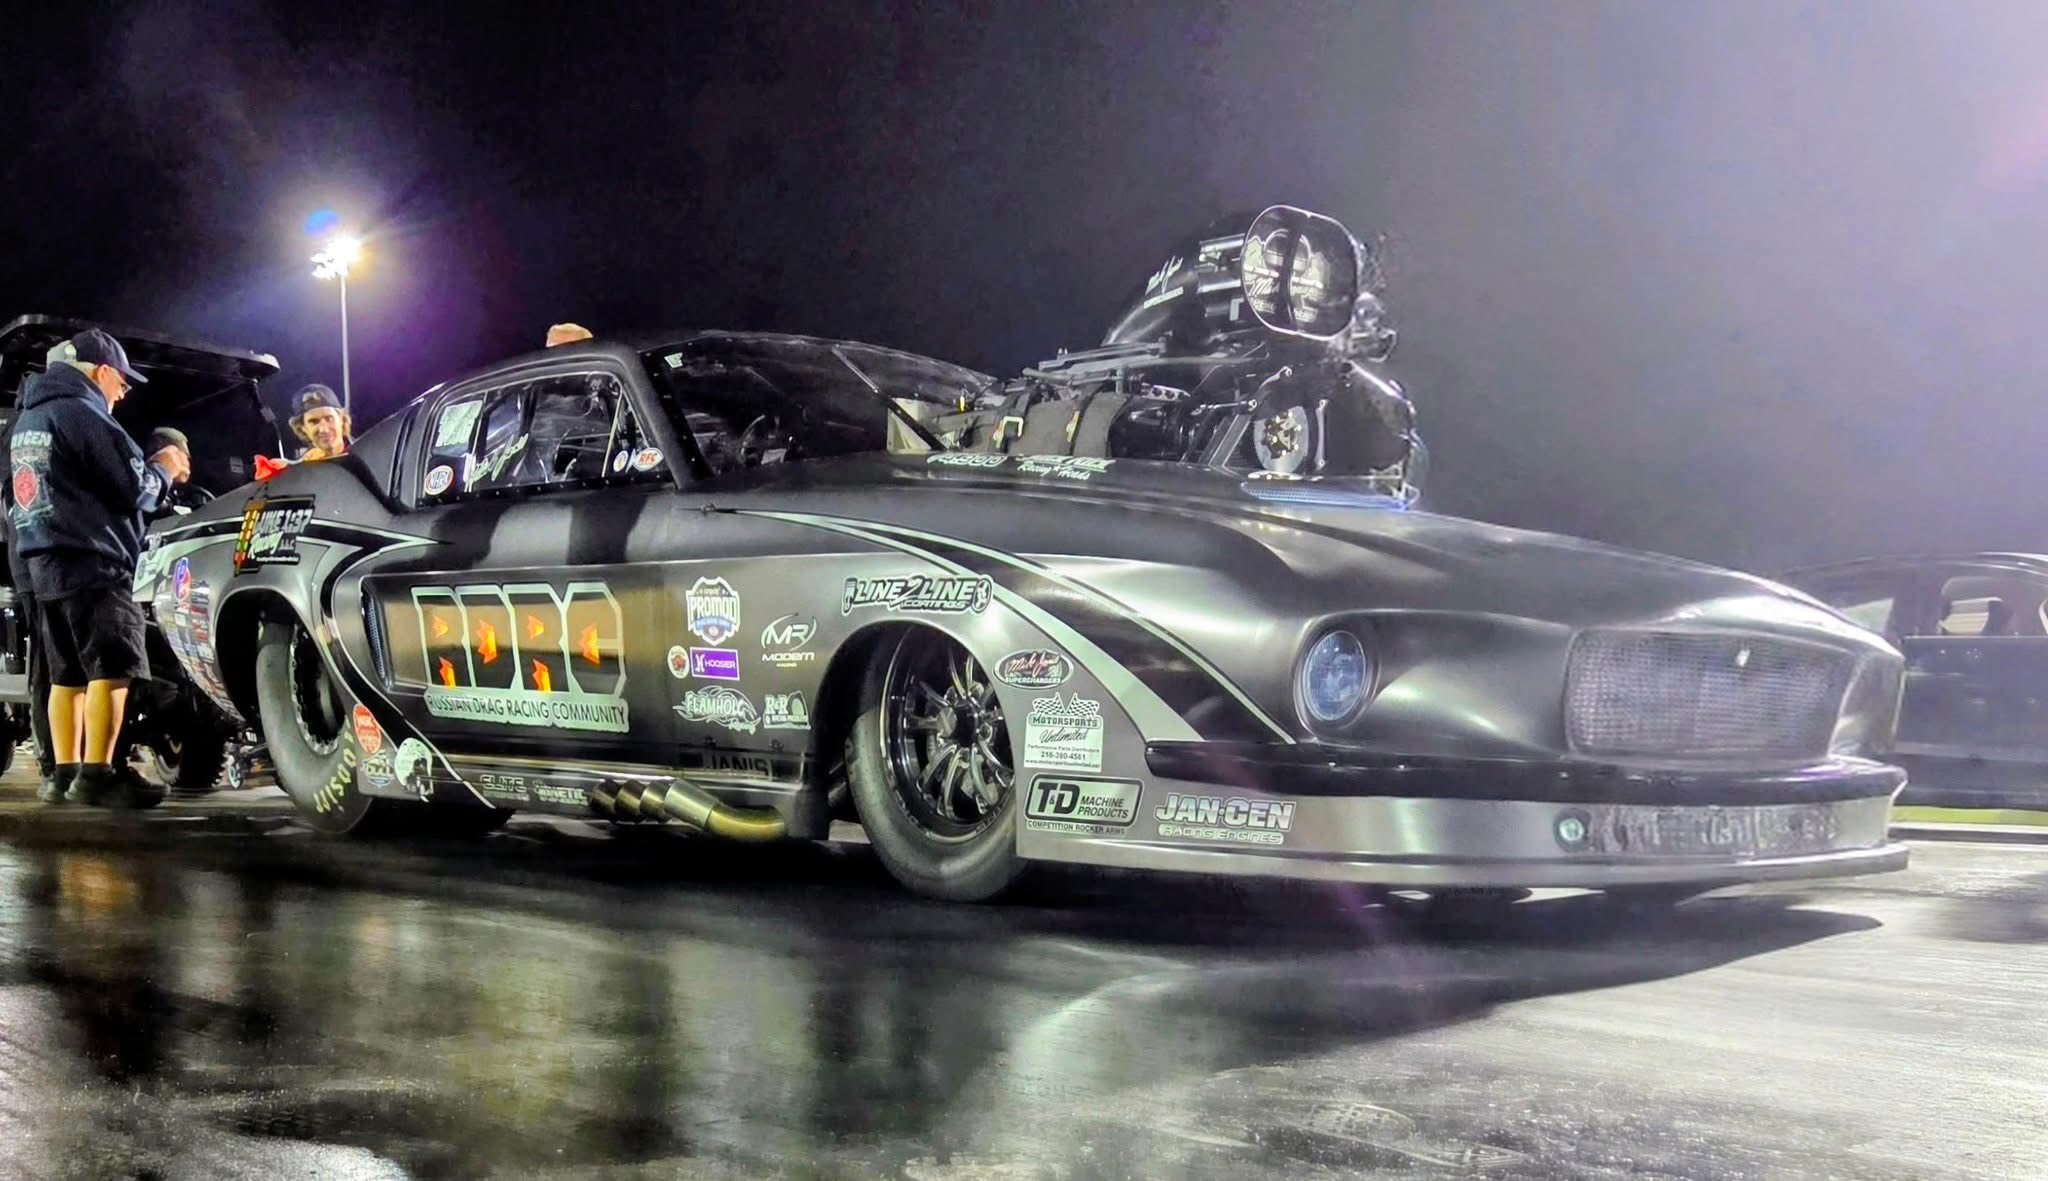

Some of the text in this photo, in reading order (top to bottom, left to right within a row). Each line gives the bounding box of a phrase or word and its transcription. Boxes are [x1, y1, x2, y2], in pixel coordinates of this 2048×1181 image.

[426, 694, 626, 724] RUSSIAN DRAG RACING COMMUNITY
[1032, 716, 1098, 727] MOTORSPORTS
[1040, 727, 1089, 743] Unlimited
[1037, 782, 1125, 815] T&D MACHINE
[1077, 807, 1129, 819] PRODUCTS
[1027, 820, 1126, 835] COMPETITION ROCKER ARMS
[1162, 825, 1282, 844] RACING ENGINES
